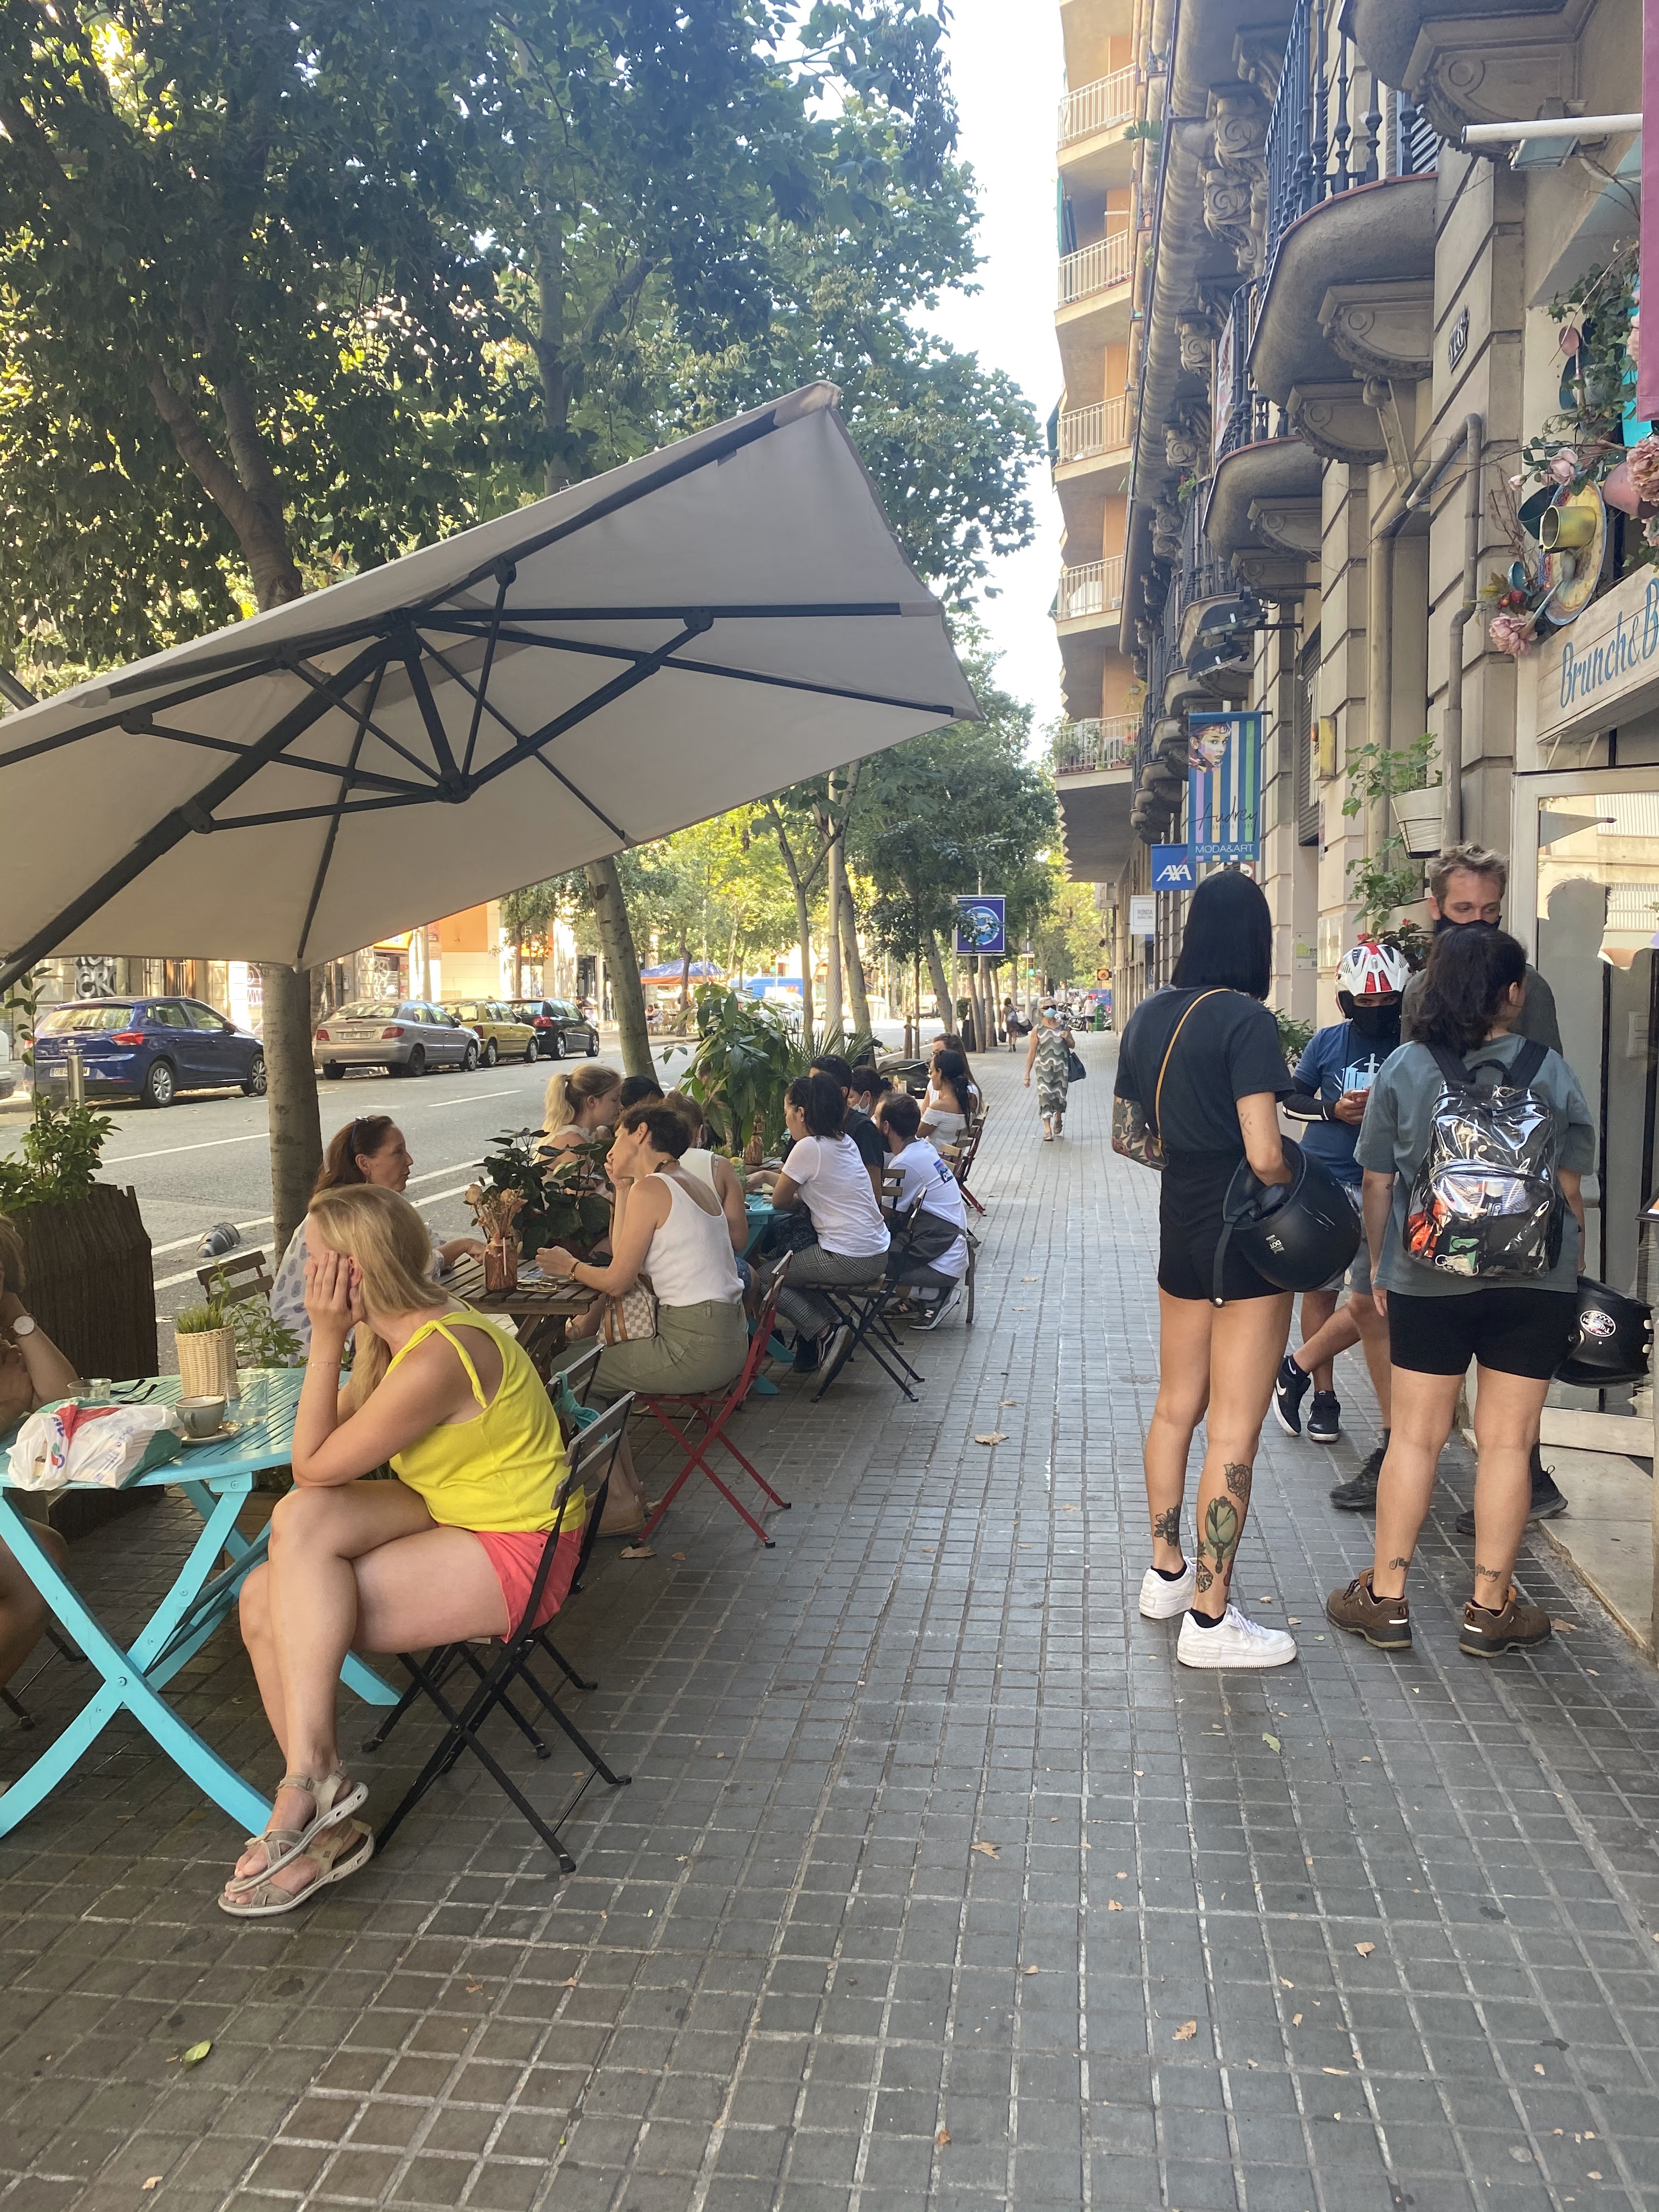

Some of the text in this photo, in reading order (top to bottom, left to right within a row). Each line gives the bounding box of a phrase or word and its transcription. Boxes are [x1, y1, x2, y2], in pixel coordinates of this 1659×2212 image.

[1189, 795, 1258, 841] Audrey
[1195, 844, 1254, 853] MODA&ART
[1155, 864, 1192, 882] AXA
[1269, 1239, 1282, 1249] DOT
